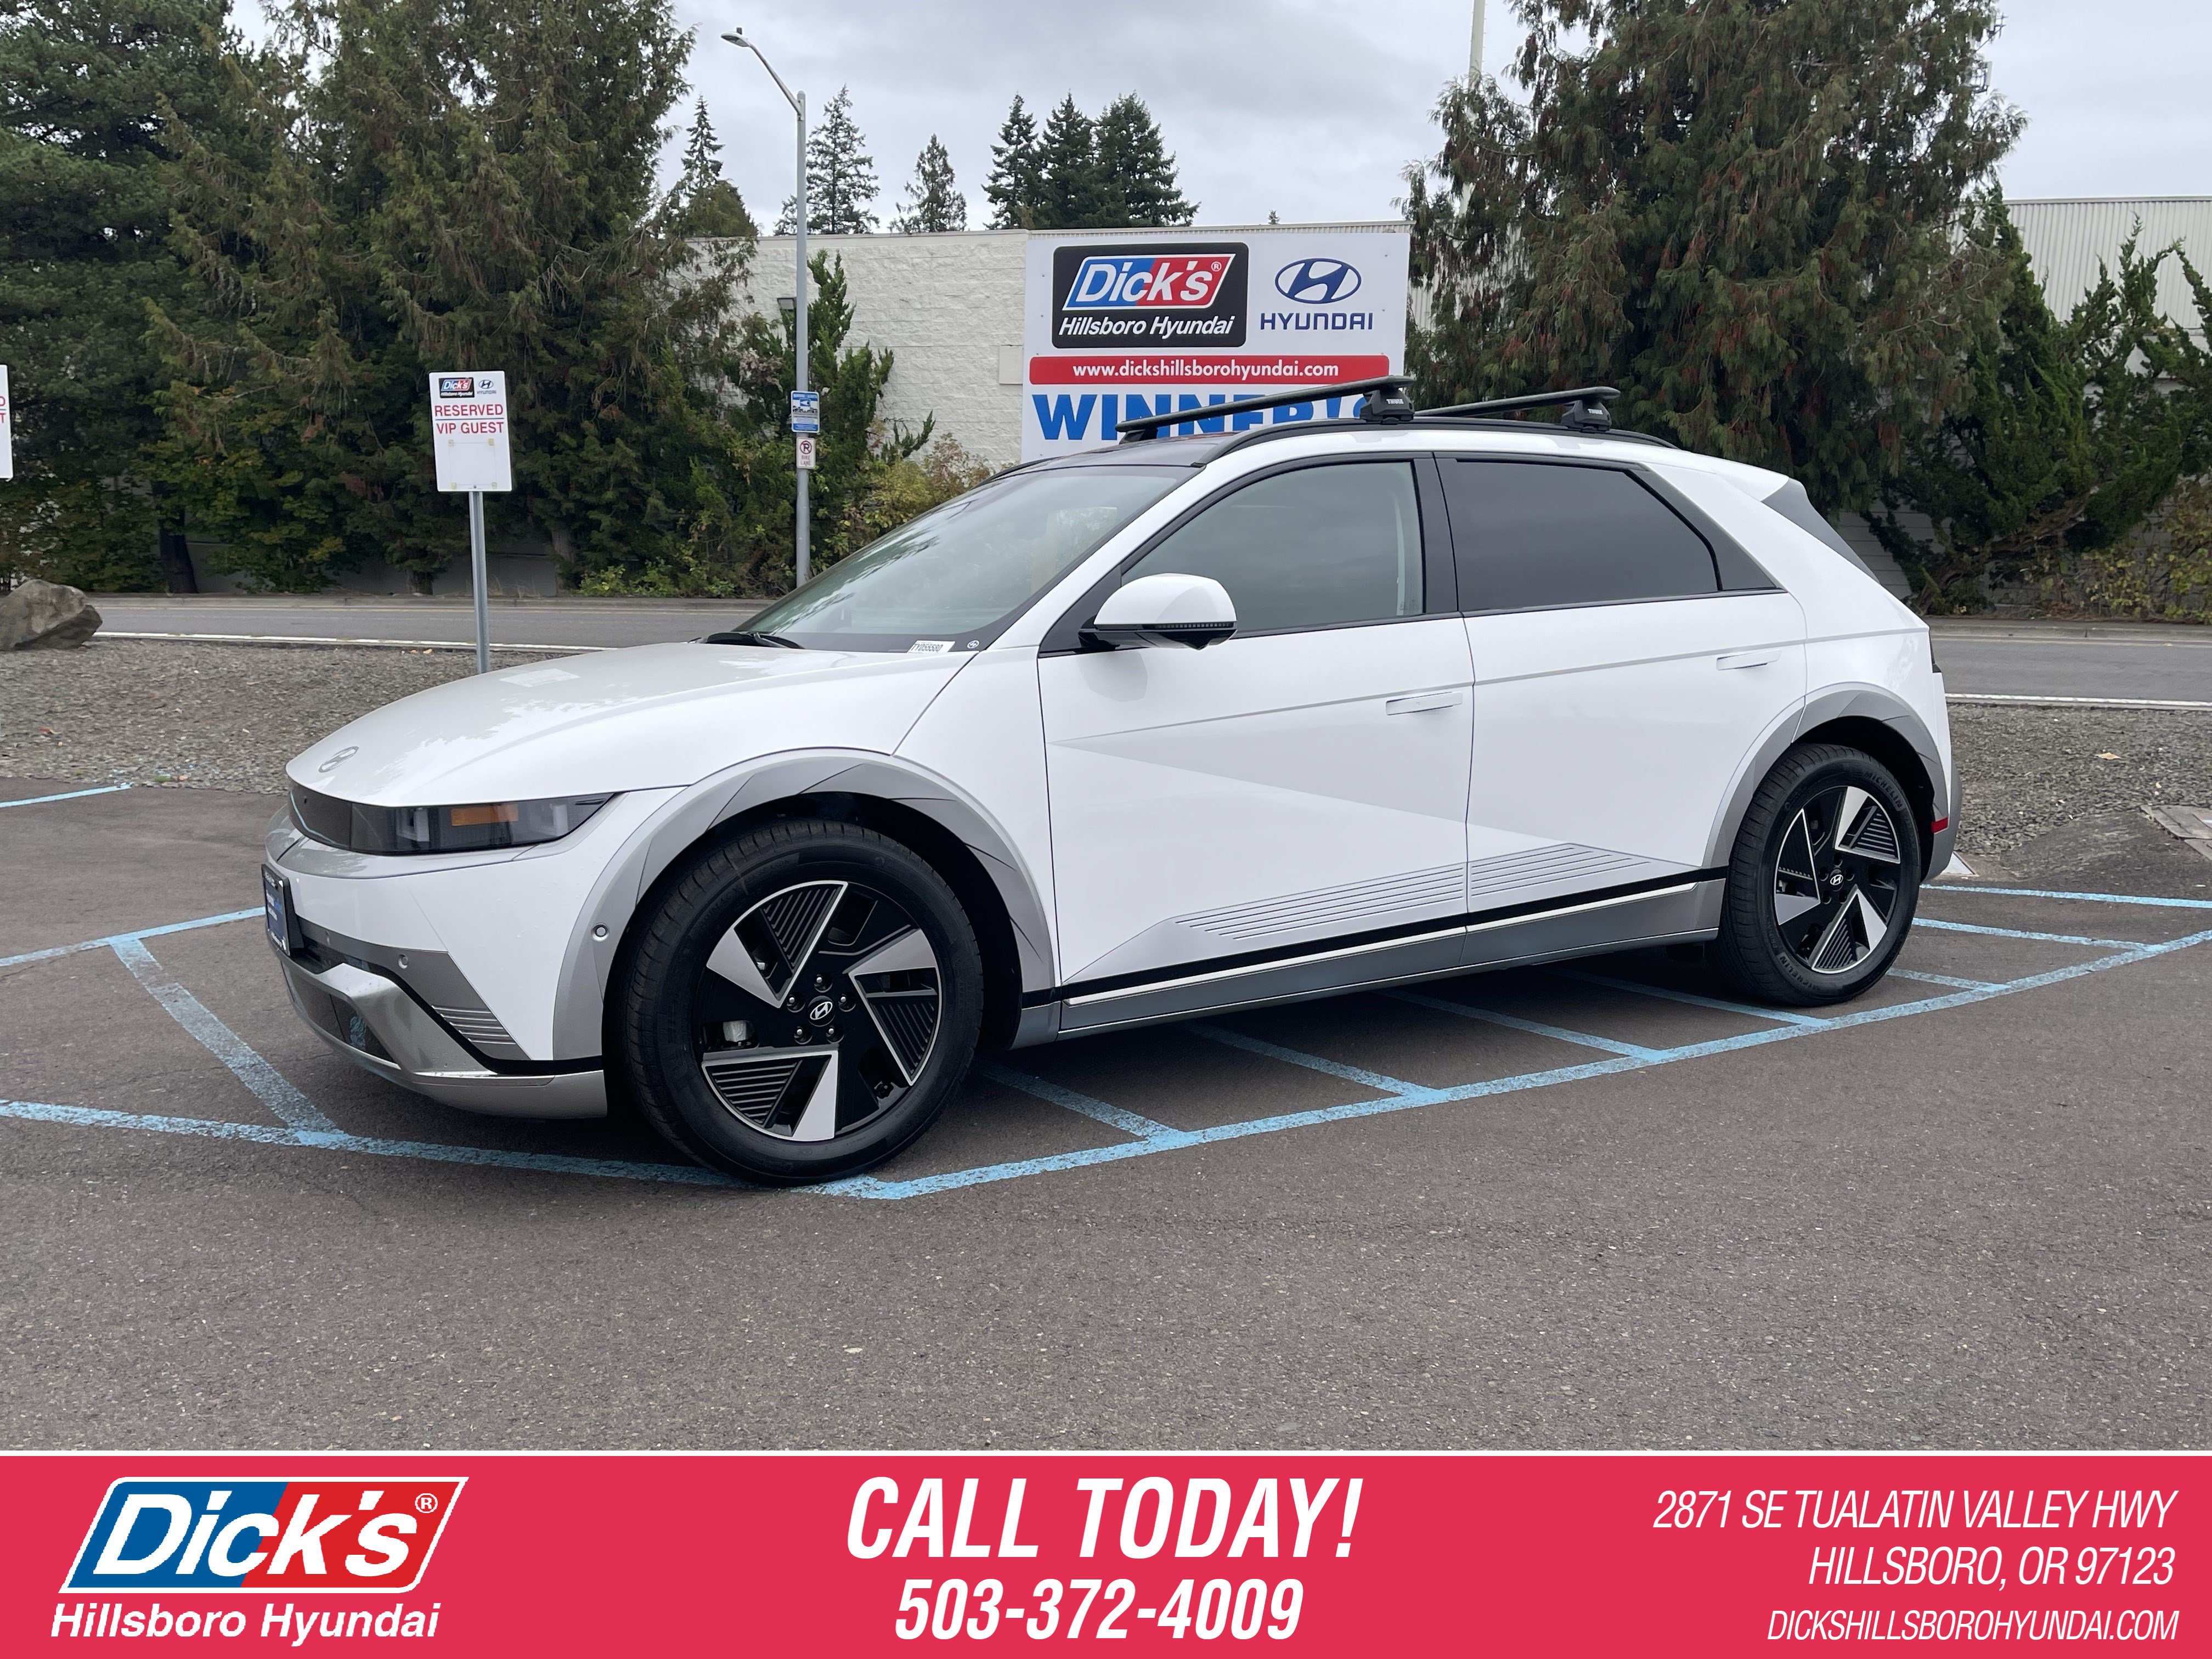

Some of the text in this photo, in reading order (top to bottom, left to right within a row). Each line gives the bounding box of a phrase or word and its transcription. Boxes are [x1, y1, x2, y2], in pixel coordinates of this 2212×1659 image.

[1058, 315, 1235, 340] Hillsboro Hyundai
[1261, 313, 1373, 330] HYUNDAI
[1073, 359, 1339, 381] www.dickshillsborohyundai.com
[435, 404, 503, 416] RESERVED
[437, 422, 504, 434] VIP GUEST
[1865, 771, 1903, 809] MICHELIN
